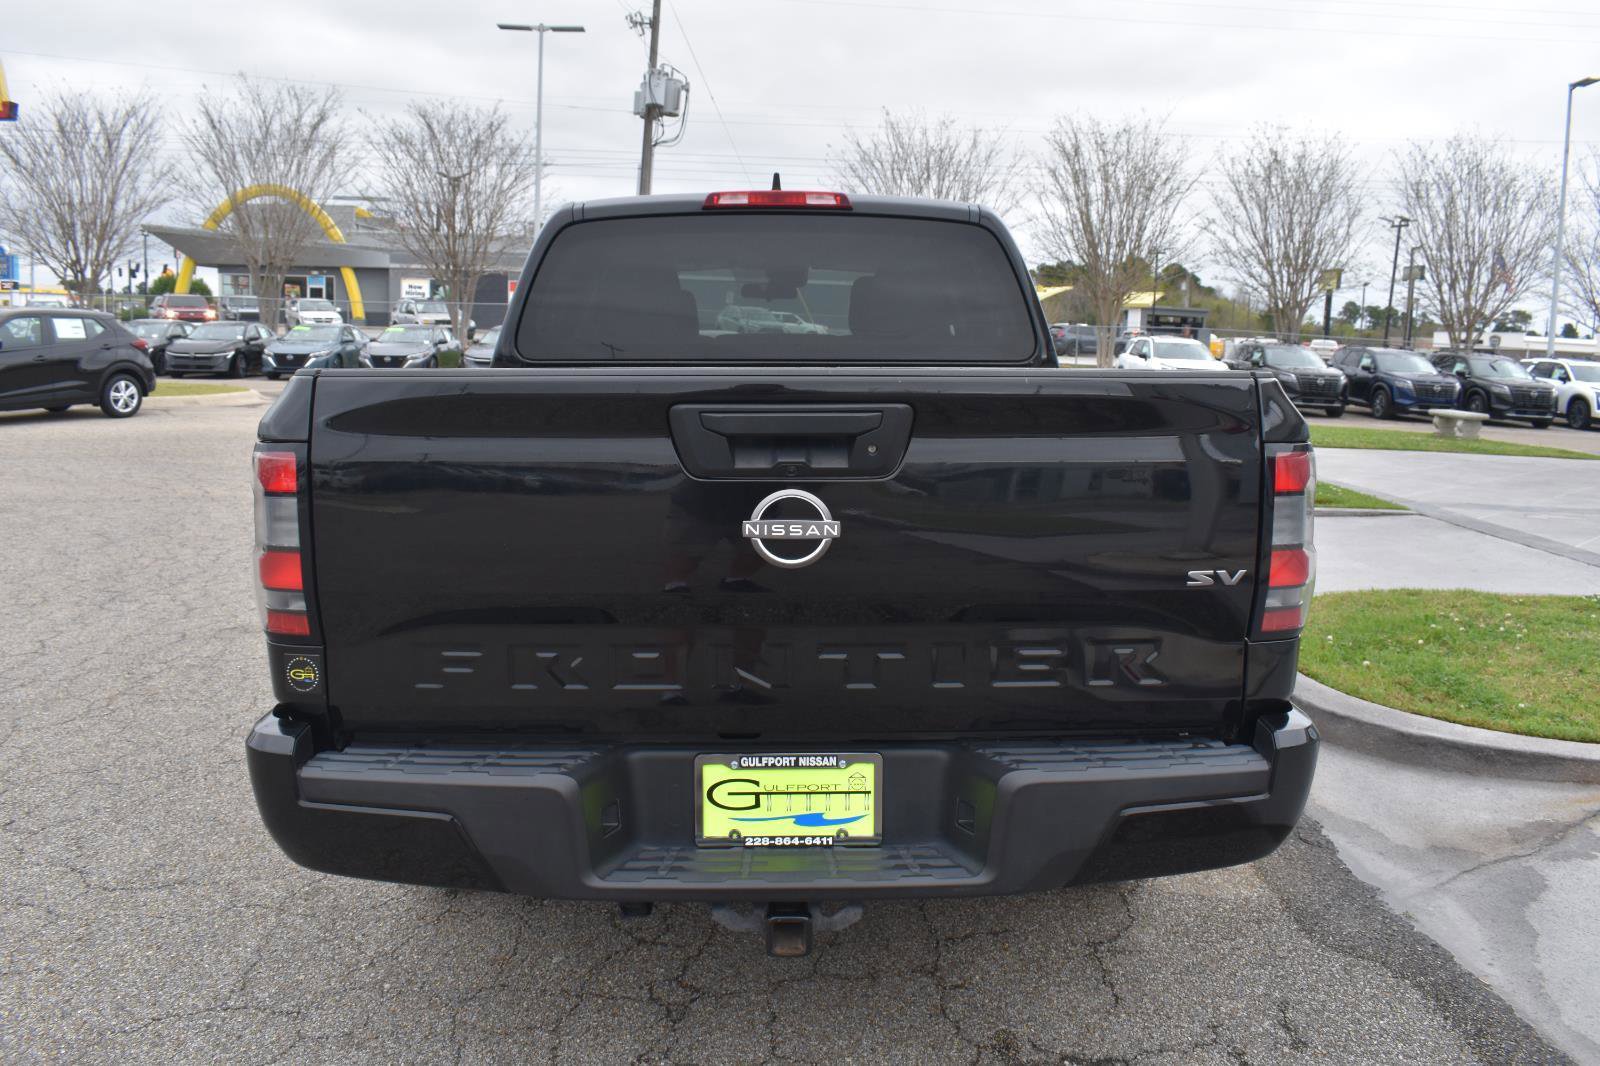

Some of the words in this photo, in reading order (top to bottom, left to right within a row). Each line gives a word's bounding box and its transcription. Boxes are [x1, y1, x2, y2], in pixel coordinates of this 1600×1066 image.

[745, 523, 838, 536] NISSAN
[1186, 569, 1248, 587] SV
[411, 638, 1166, 691] FRONTIER
[740, 756, 797, 767] GULFPORT
[798, 756, 837, 767] NISSAN
[744, 836, 834, 846] 228-864-6411
